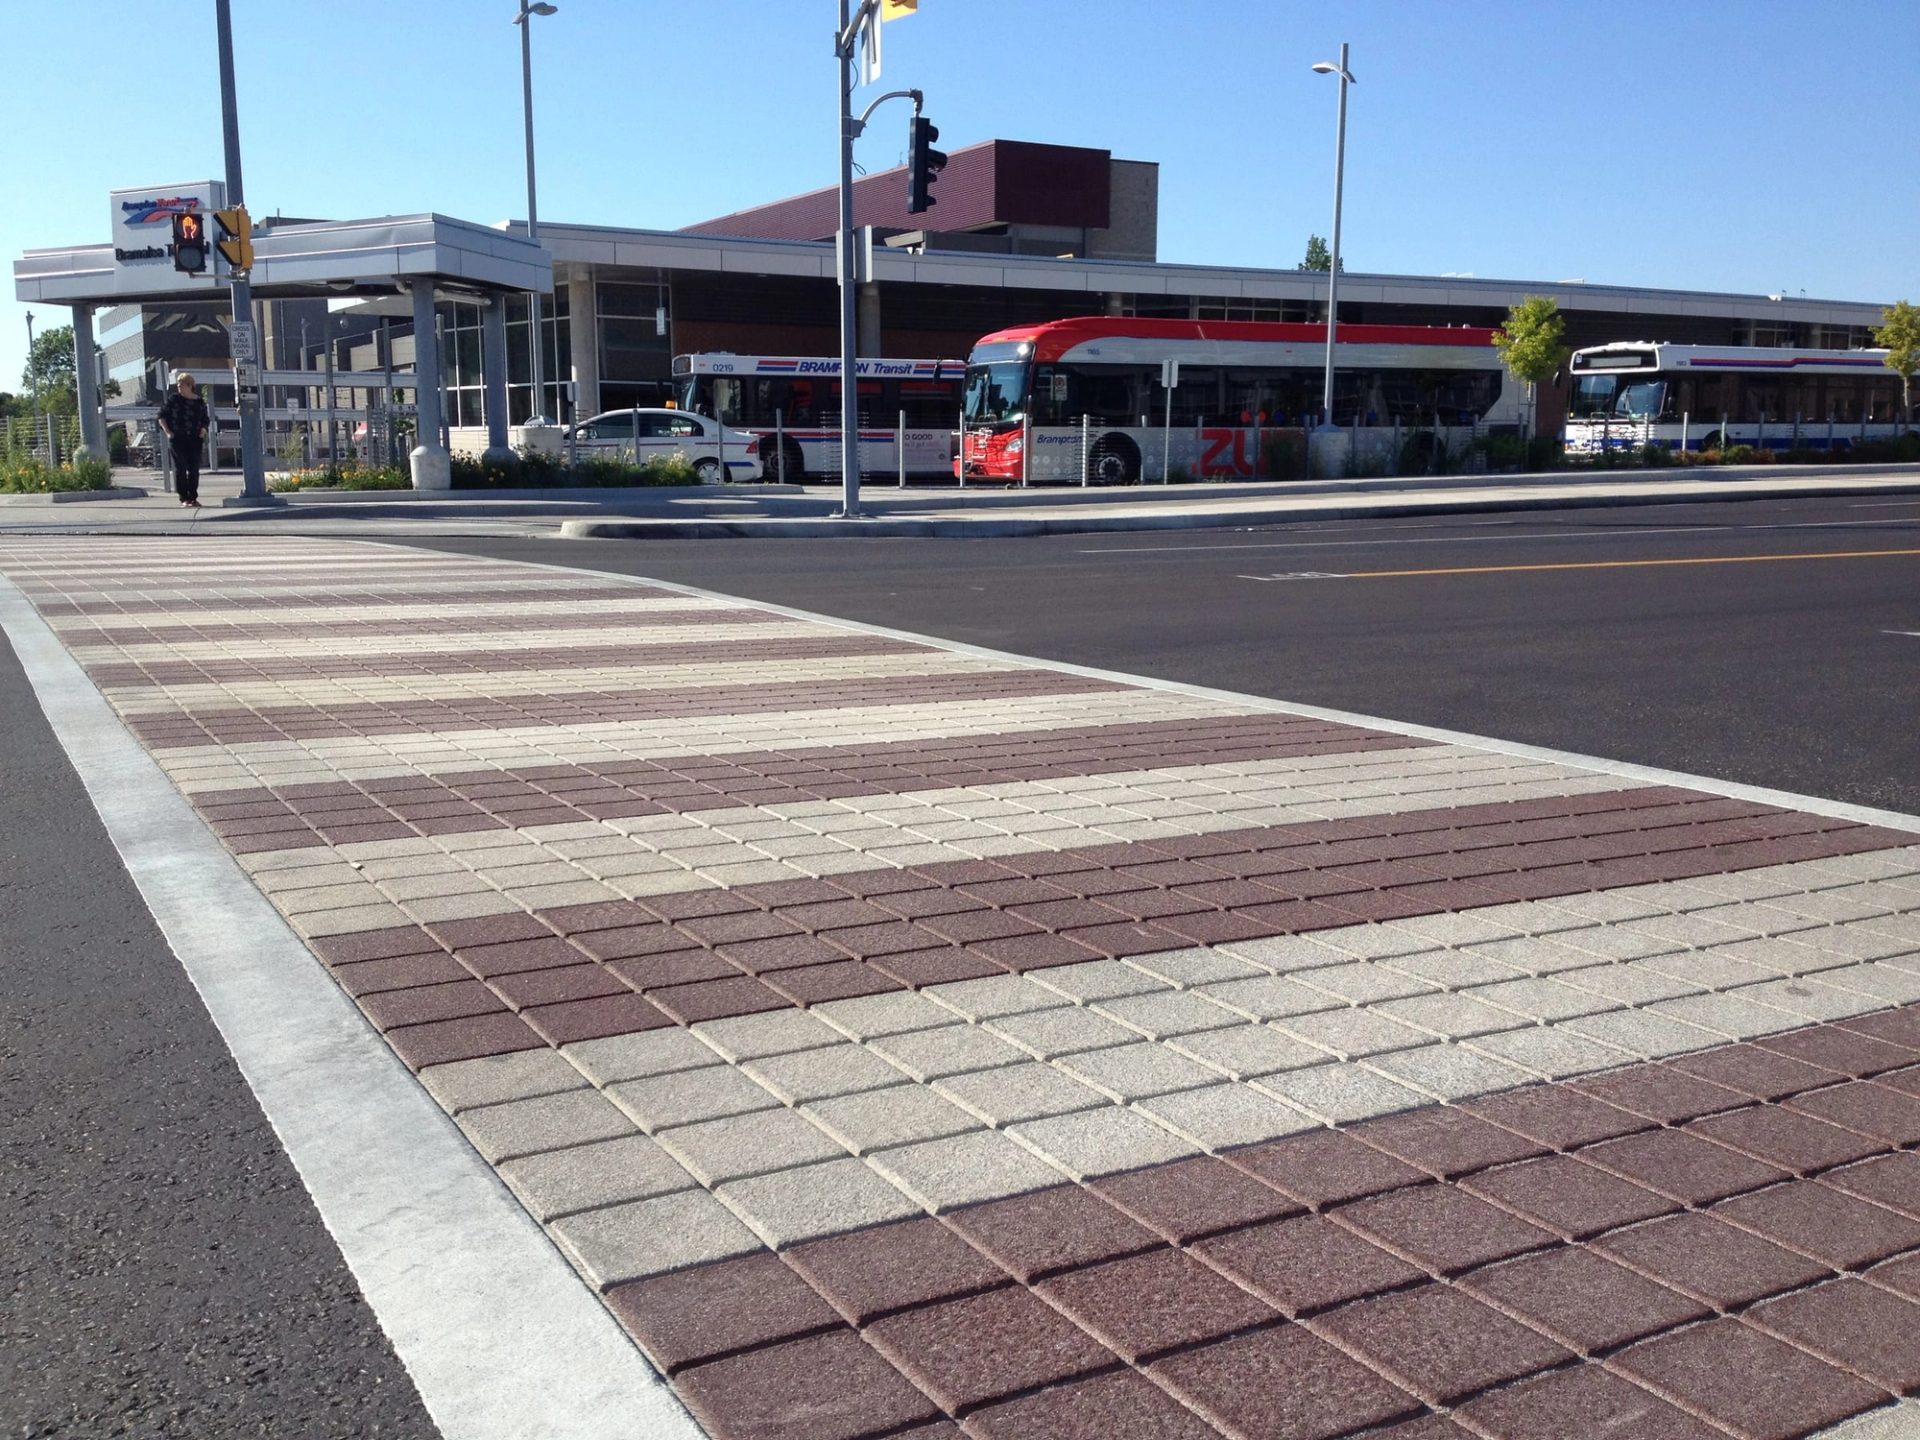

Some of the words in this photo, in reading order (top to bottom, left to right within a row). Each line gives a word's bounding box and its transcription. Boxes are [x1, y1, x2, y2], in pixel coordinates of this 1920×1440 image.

[115, 245, 165, 261] Bramalea
[712, 363, 734, 373] 0219
[873, 363, 913, 375] Transit
[911, 433, 933, 441] GOOD
[1036, 434, 1084, 446] Brampton
